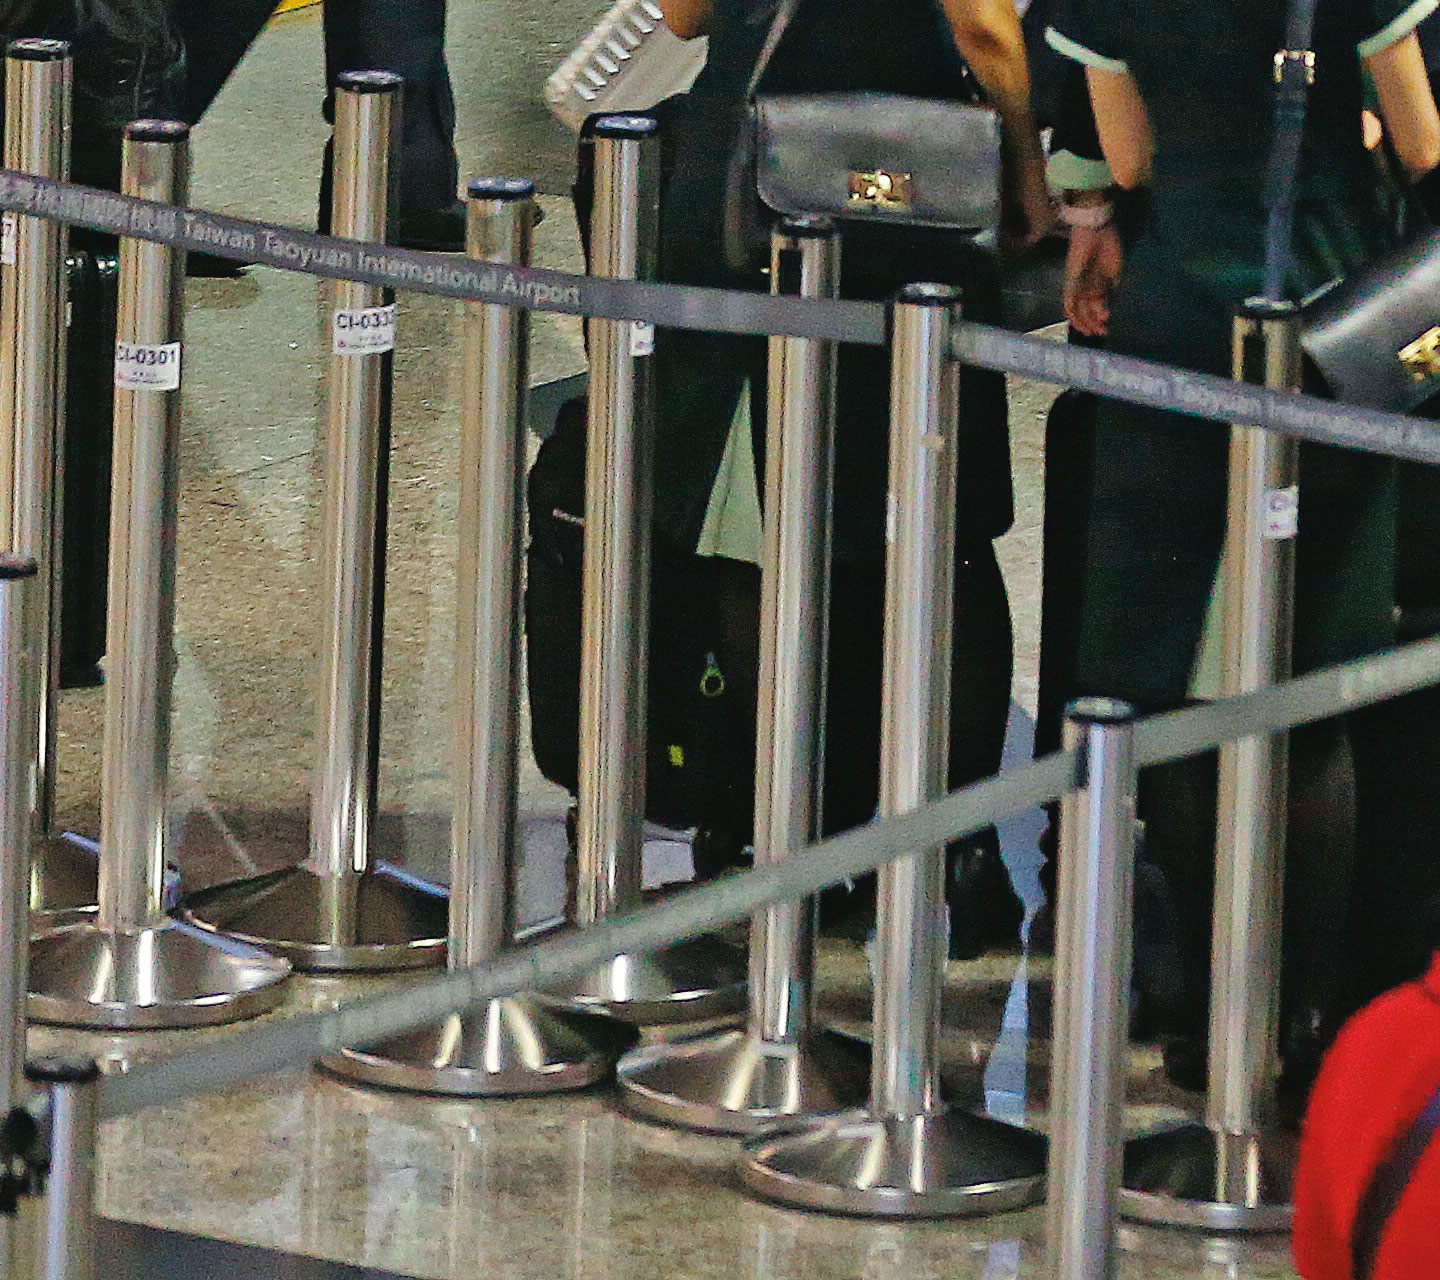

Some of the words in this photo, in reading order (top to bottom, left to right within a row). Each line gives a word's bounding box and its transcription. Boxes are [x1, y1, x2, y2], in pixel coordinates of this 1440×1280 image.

[182, 213, 258, 252] Taiwan
[259, 225, 355, 271] Taoyuan
[356, 239, 500, 292] International
[501, 269, 582, 307] Airport
